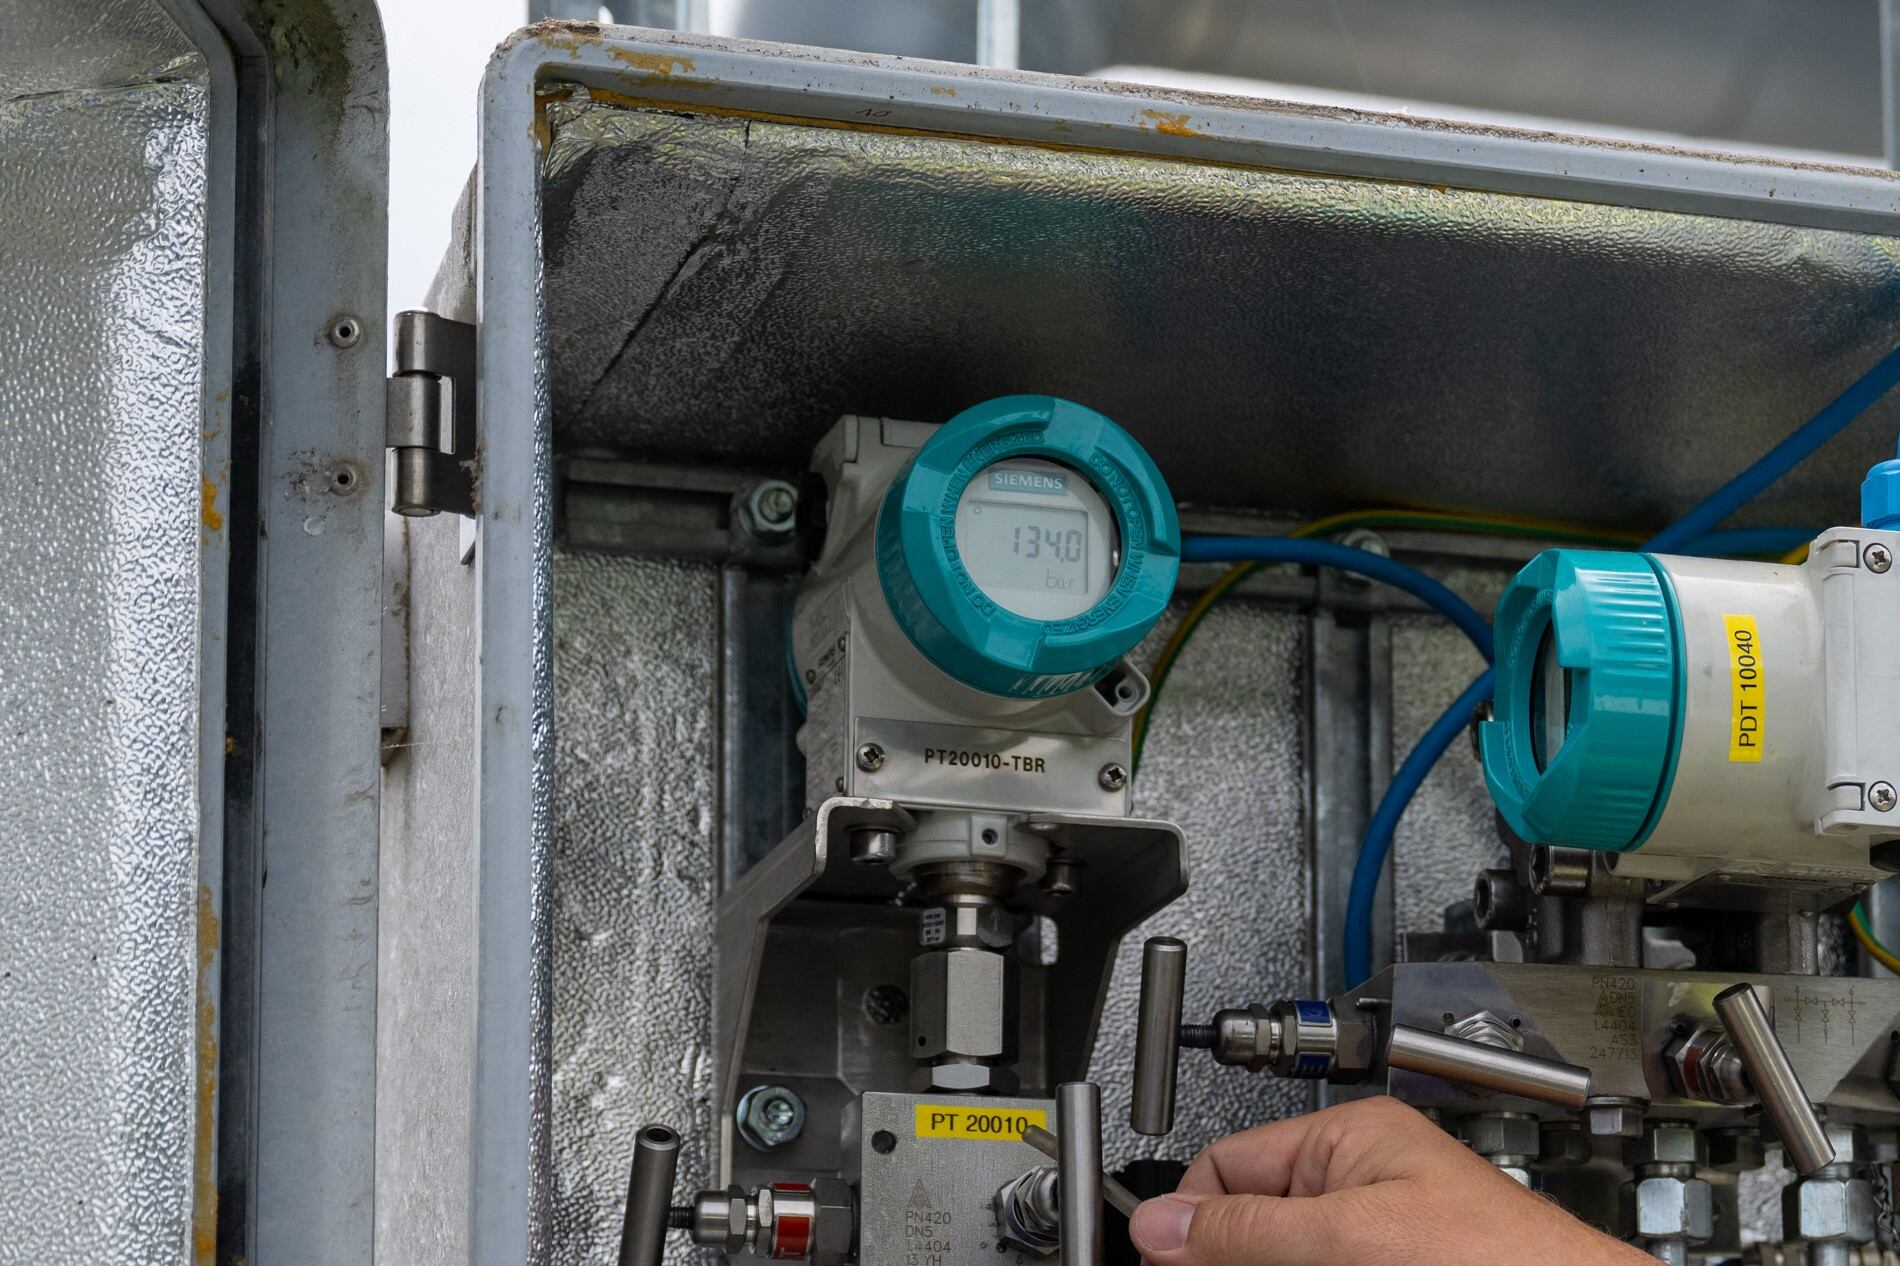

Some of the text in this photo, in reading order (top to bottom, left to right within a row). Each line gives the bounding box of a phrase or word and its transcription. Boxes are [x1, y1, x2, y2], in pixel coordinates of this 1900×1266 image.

[994, 473, 1063, 490] SIEMENS
[1046, 567, 1075, 590] bar
[1734, 630, 1758, 747] PDT 10040
[924, 747, 1045, 773] PT20010-TBR
[931, 1113, 1028, 1135] PT 20010
[906, 1211, 951, 1224] PN420
[905, 1224, 933, 1238] DN5
